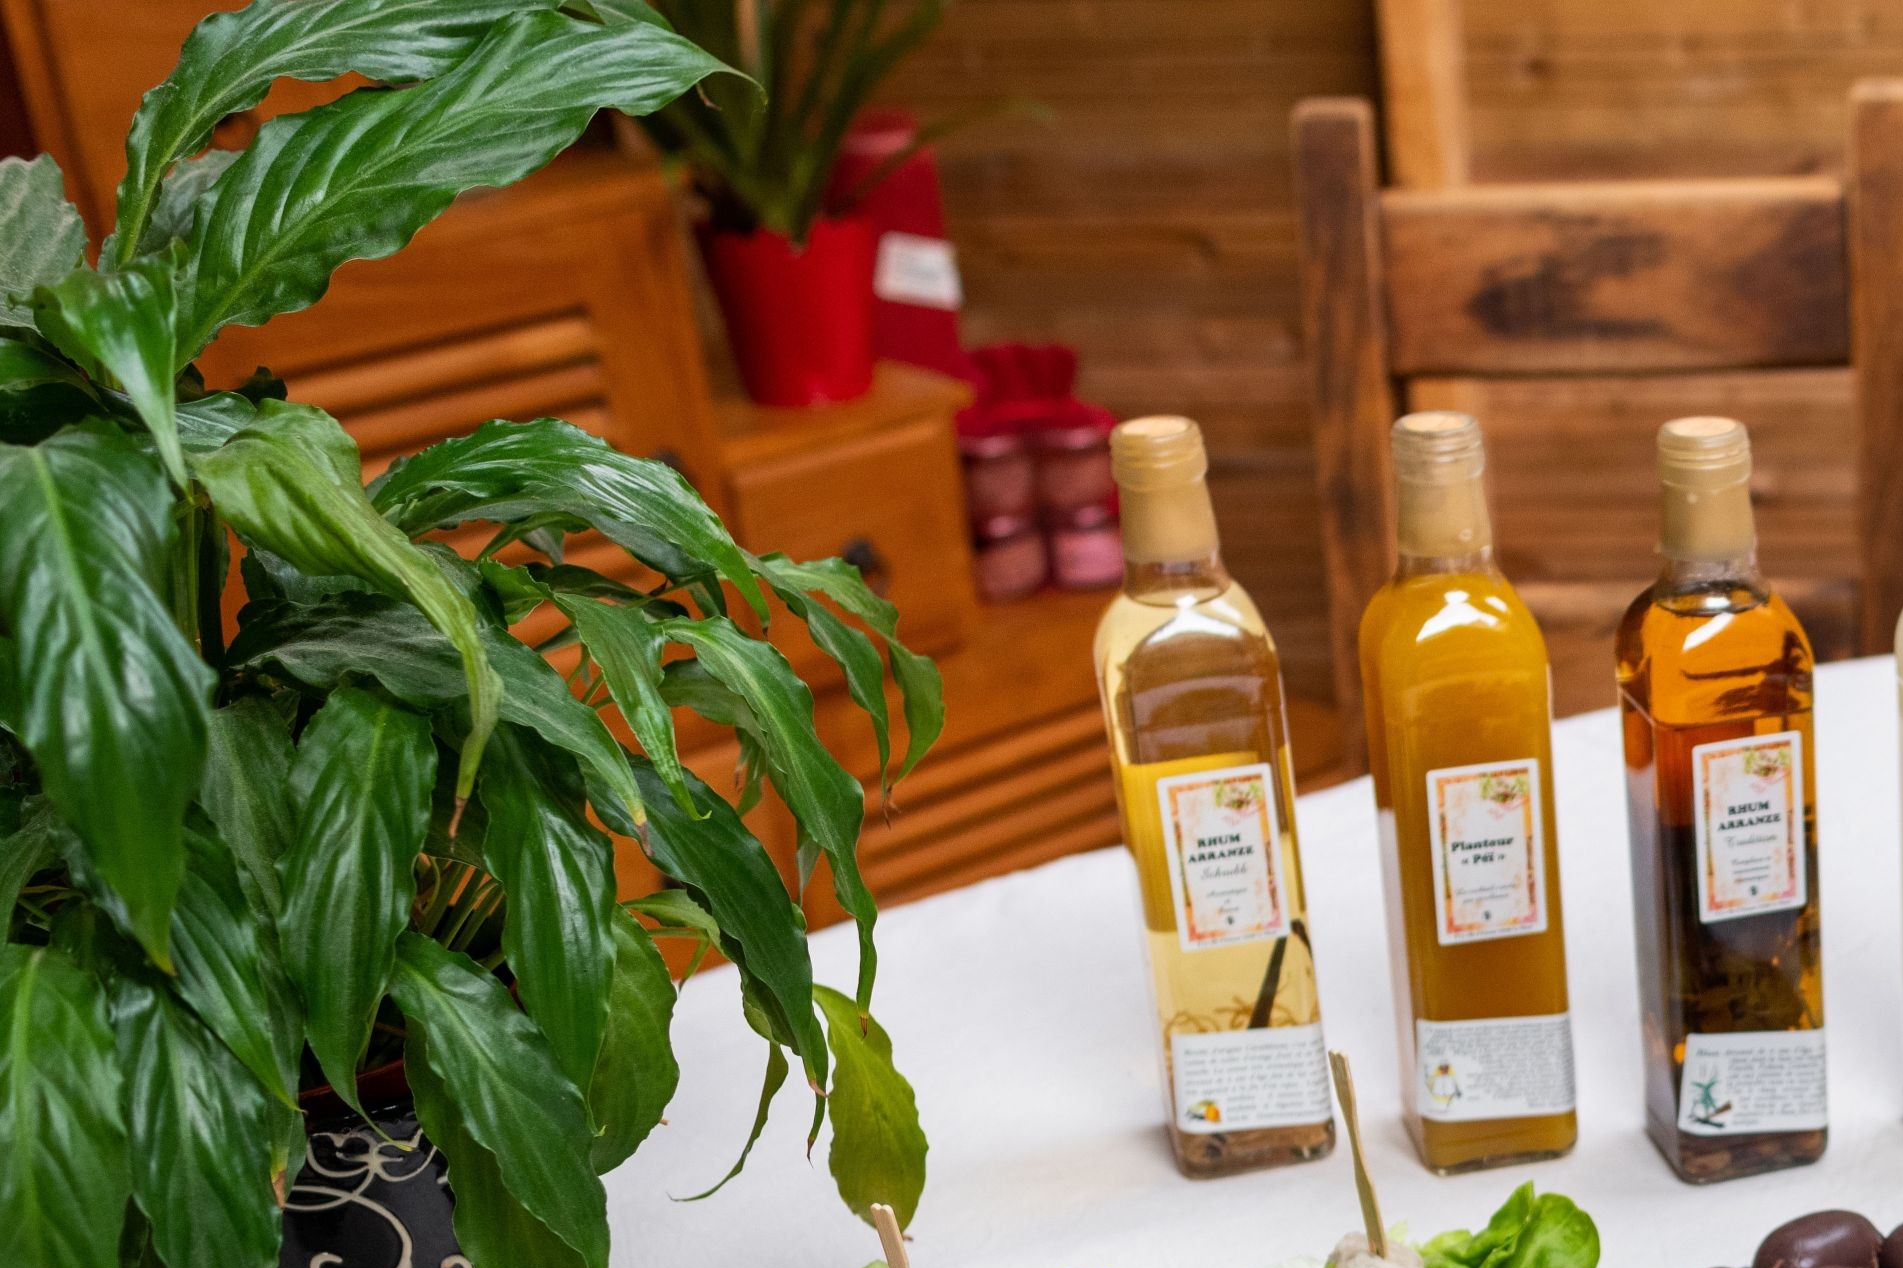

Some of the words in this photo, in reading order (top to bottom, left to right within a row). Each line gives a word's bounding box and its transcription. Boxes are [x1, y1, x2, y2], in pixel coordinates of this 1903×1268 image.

[1728, 800, 1770, 816] RHUM
[1197, 832, 1242, 849] RHUM
[1451, 836, 1515, 853] Planteur
